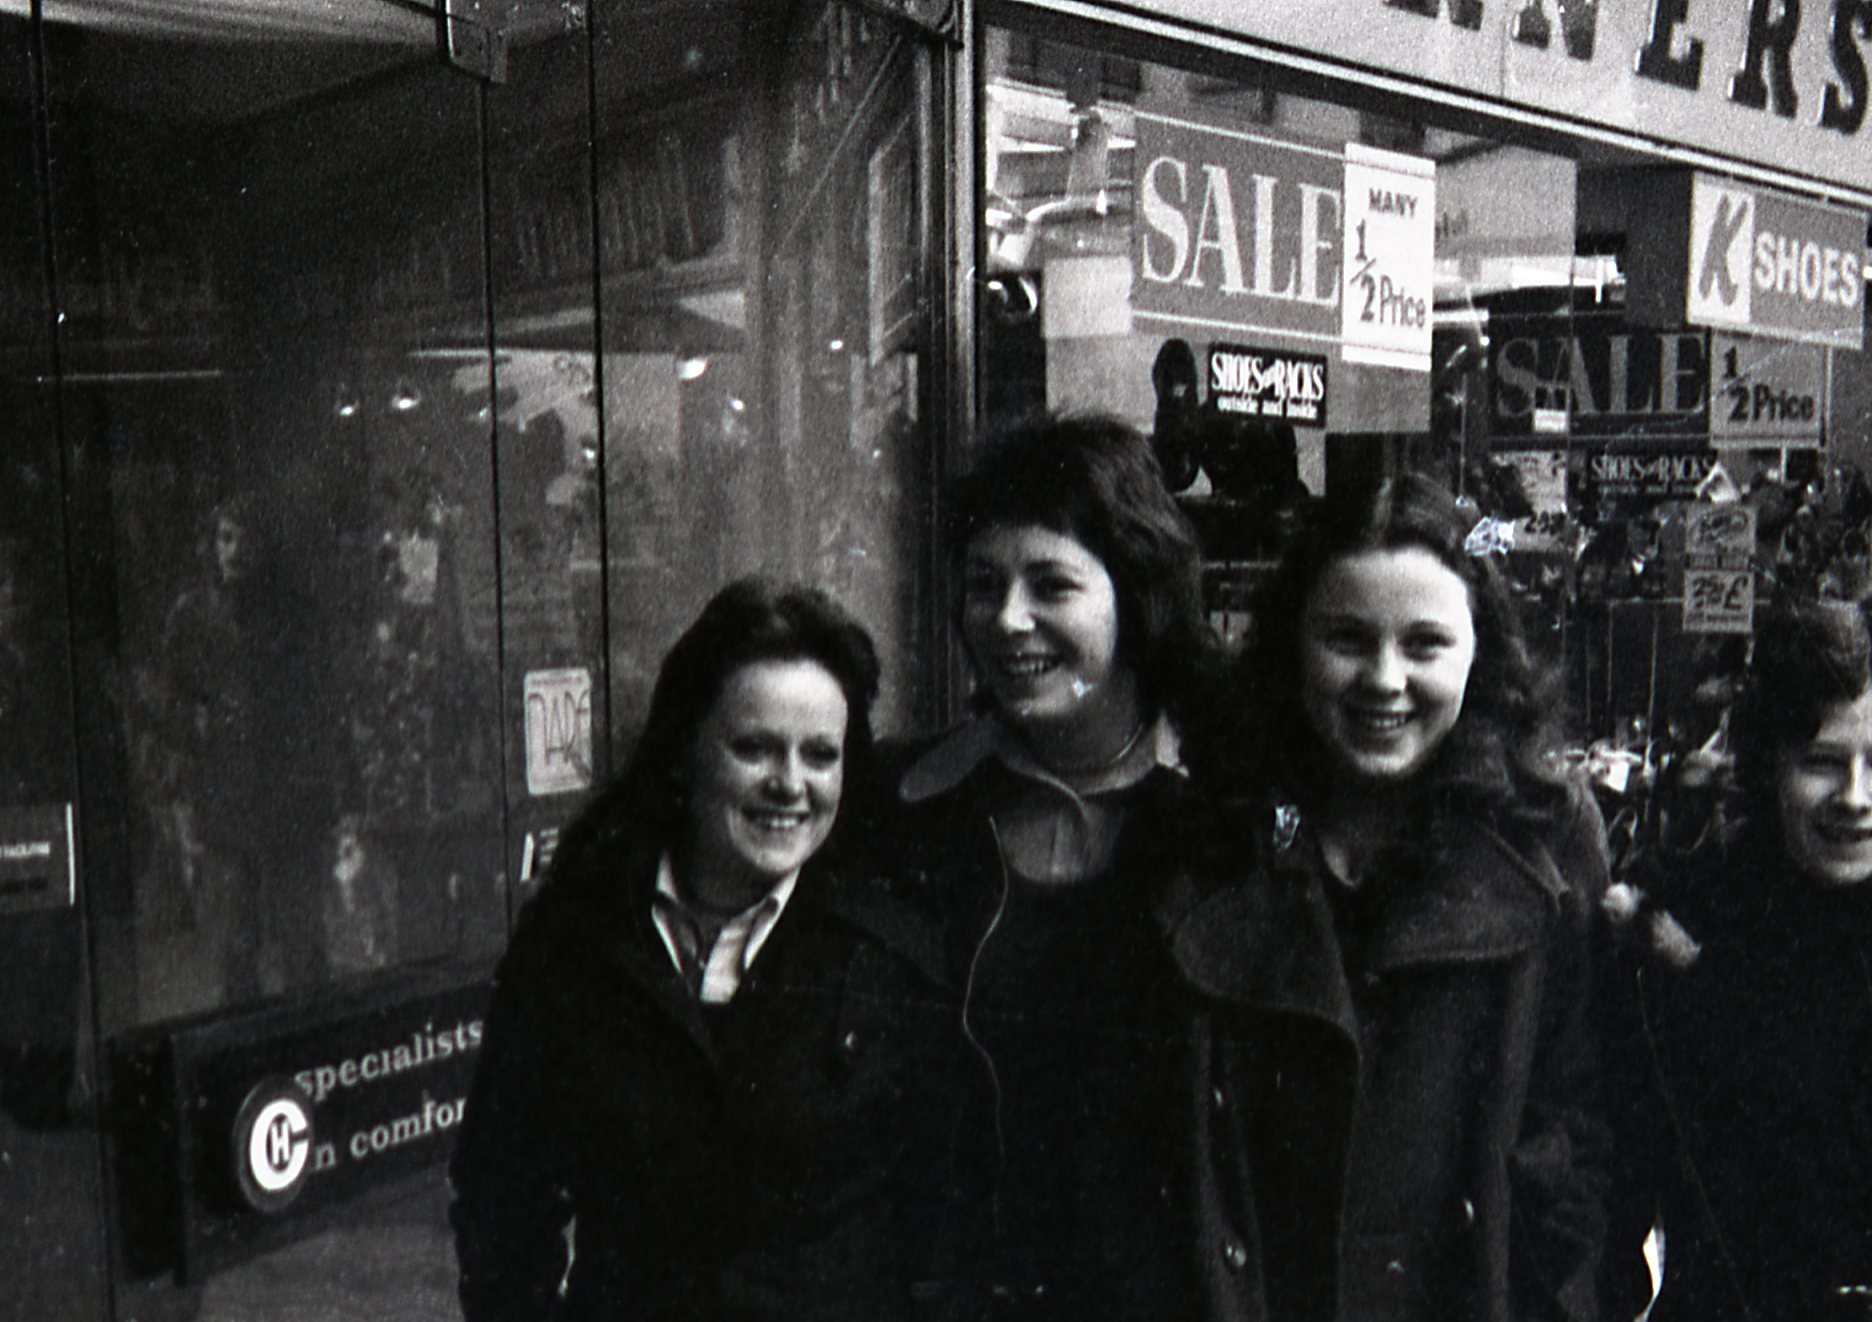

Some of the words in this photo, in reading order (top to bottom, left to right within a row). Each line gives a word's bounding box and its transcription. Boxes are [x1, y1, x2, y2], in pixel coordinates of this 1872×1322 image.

[1142, 157, 1342, 308] SALE
[1369, 188, 1418, 216] MANY
[1700, 193, 1748, 306] K
[1753, 231, 1860, 308] SHOES
[1379, 275, 1427, 329] Price
[1211, 352, 1262, 394] SHOES
[1498, 335, 1707, 417] SALE
[1750, 383, 1817, 421] Price
[295, 1018, 483, 1102] specialists
